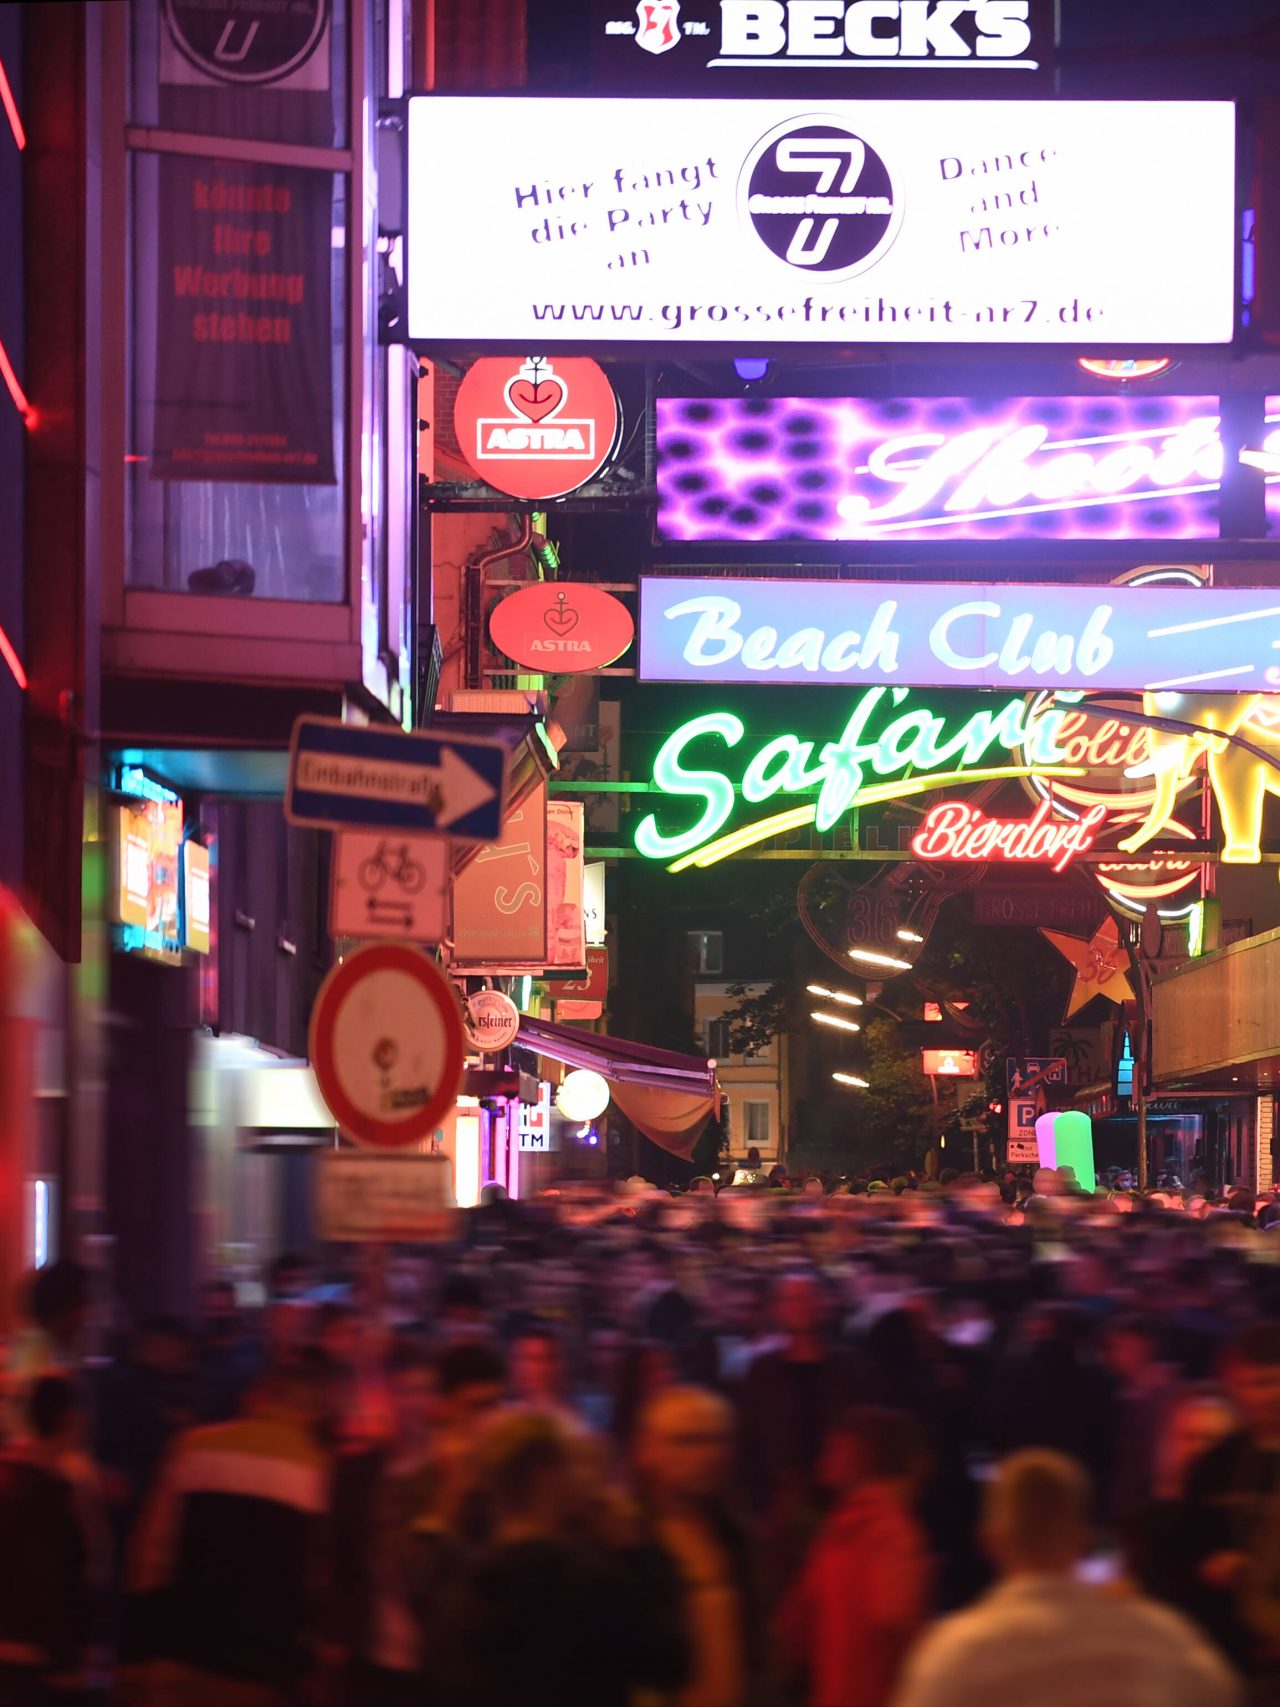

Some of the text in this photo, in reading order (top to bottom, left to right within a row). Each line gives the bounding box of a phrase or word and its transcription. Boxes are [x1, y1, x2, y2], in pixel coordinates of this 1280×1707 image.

[719, 0, 1032, 57] BECK'S
[607, 199, 713, 232] Party
[959, 224, 1060, 253] More
[486, 428, 586, 450] ASTRA
[530, 640, 593, 652] ASTRA
[664, 596, 1114, 676] Beach Club
[633, 687, 1085, 858] Safari
[913, 802, 1106, 872] Bierdorf
[519, 1133, 544, 1147] TM
[1018, 1129, 1037, 1137] ZON
